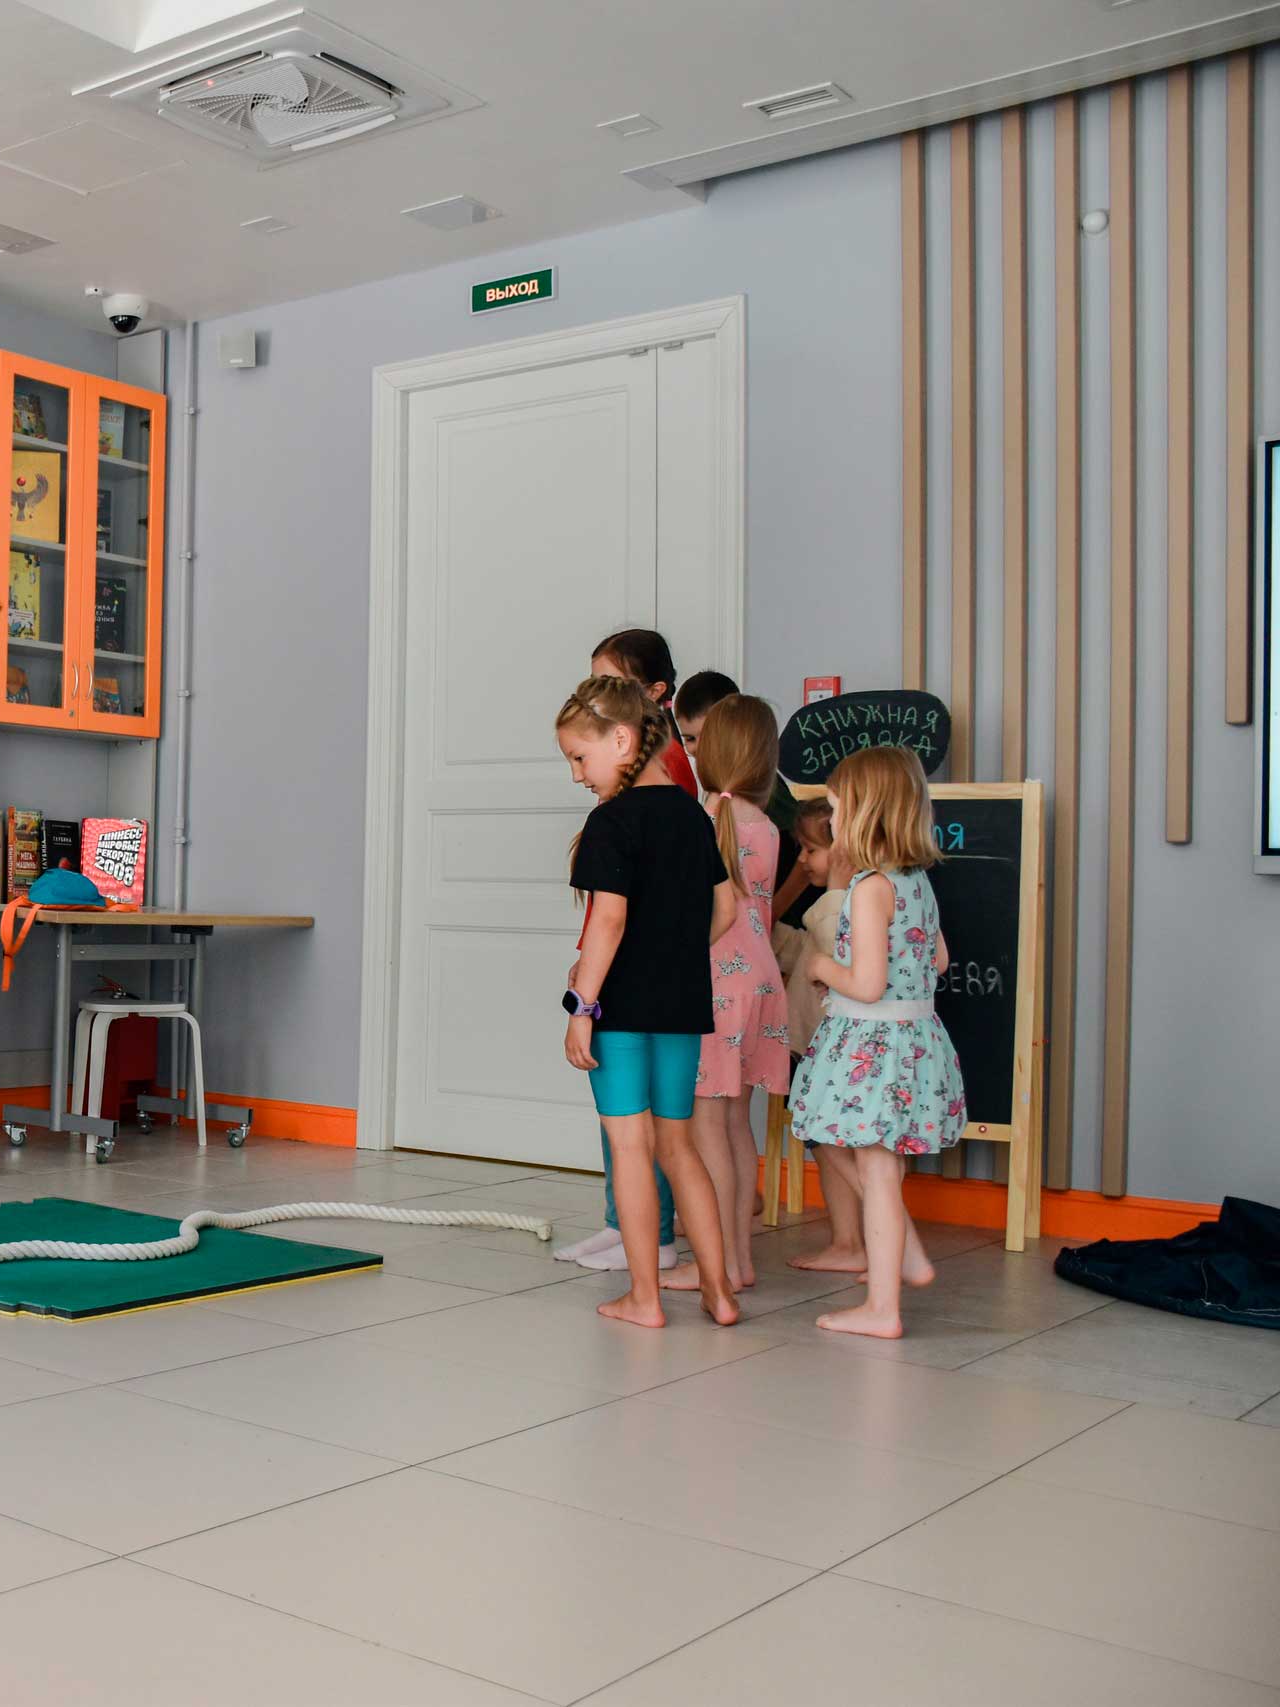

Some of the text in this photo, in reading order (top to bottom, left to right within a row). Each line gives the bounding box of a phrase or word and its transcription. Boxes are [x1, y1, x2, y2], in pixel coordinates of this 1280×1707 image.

[486, 279, 539, 303] ВЫХОД
[796, 704, 939, 739] КНИЖНАЯ
[801, 730, 937, 775] ЗАРЯДКА
[97, 840, 141, 852] МИРОВЫЕ
[99, 828, 144, 841] ГИННЕСС
[96, 847, 139, 866] РЕКОРДЫ
[94, 855, 135, 888] 2008
